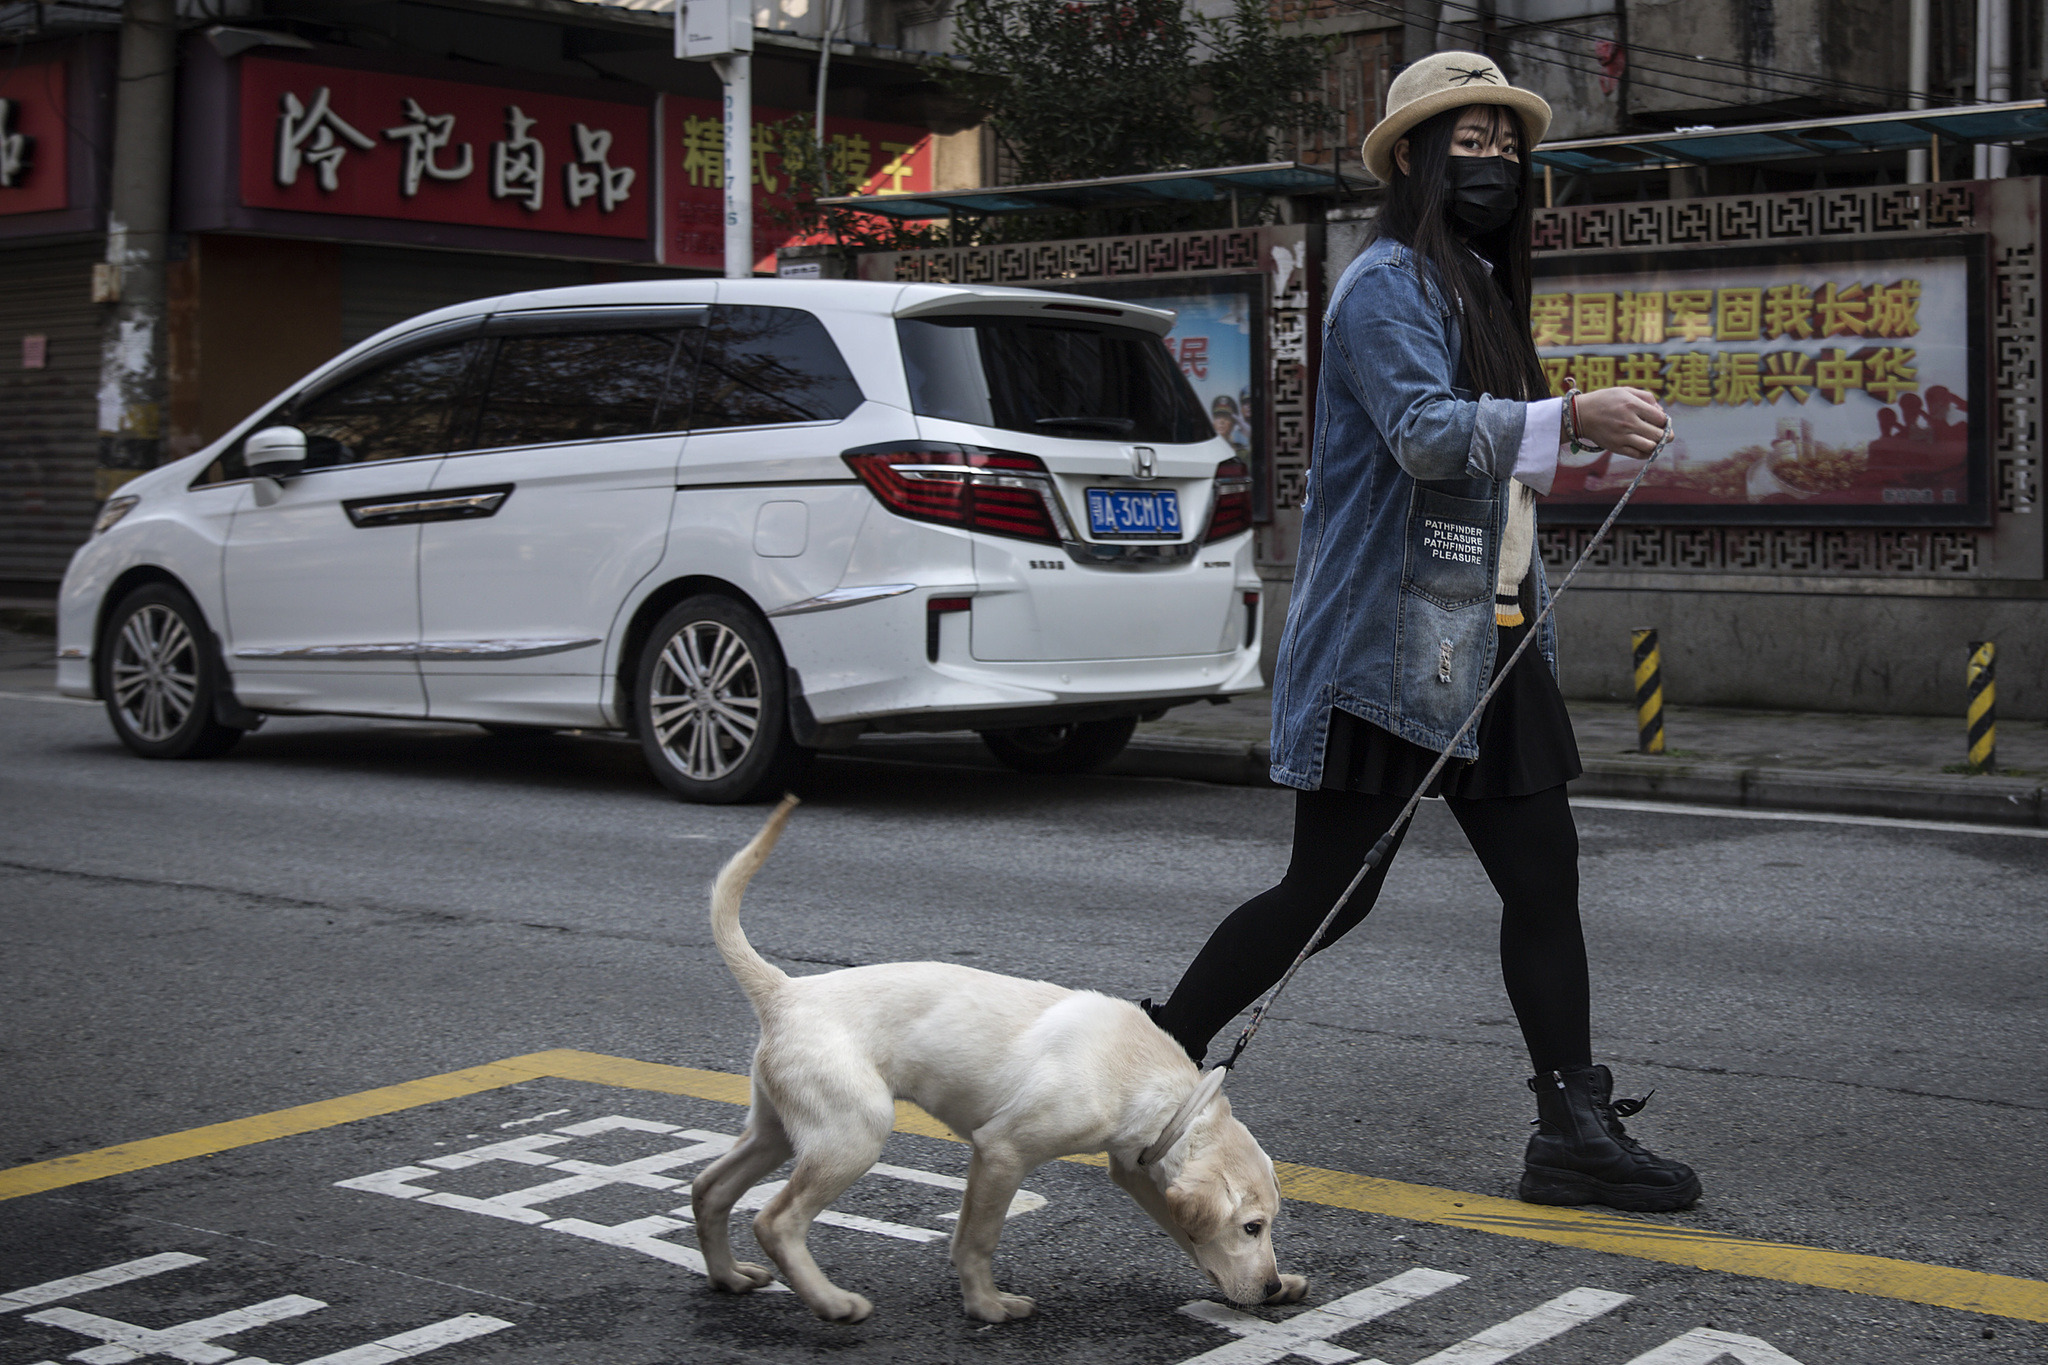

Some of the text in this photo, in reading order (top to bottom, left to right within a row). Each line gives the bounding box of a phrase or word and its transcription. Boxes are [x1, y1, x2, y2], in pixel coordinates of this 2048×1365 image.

[1531, 279, 1921, 346] 爱国拥军固我长城
[1425, 519, 1483, 536] PATHFINDER
[1424, 537, 1483, 555] PATHFINDER
[1434, 530, 1483, 546] PLEASURE
[1432, 549, 1482, 565] PLEASURE
